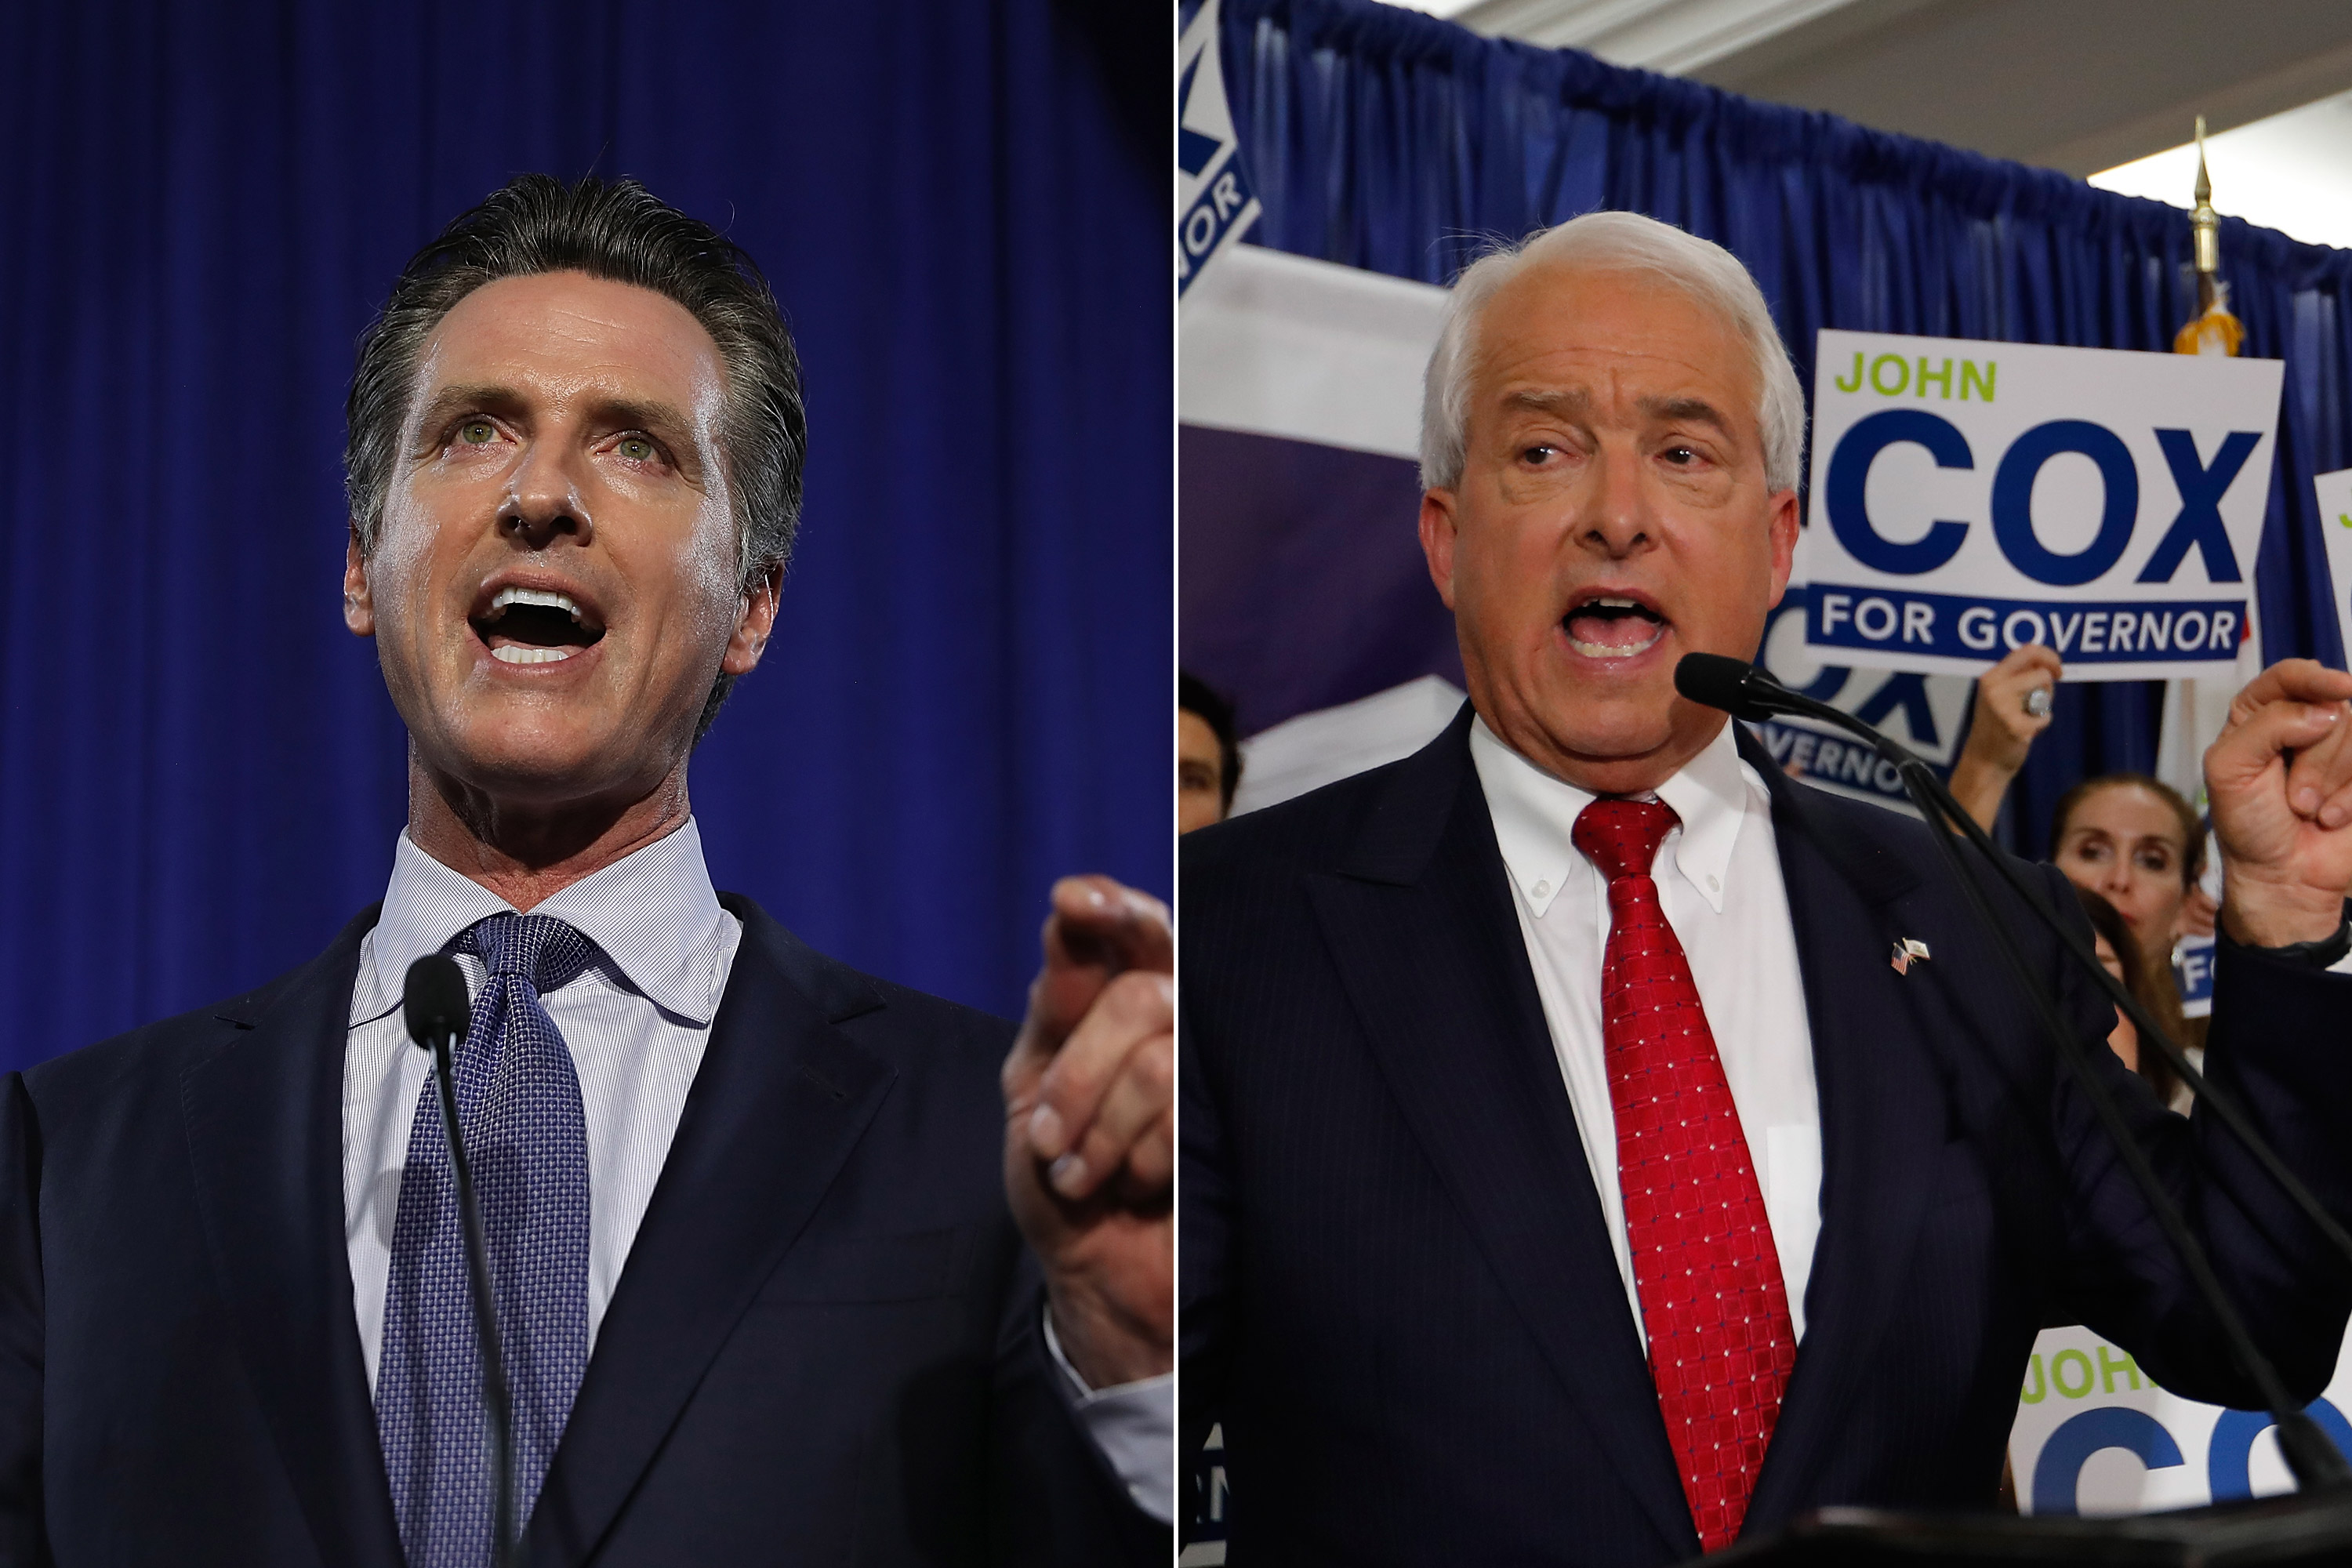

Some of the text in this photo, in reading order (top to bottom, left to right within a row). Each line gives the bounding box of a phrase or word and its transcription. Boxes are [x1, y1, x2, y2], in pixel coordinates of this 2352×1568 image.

[1835, 352, 1997, 403] JOHN
[1824, 408, 2265, 587] COX
[1821, 593, 2237, 653] FOR GOVERNOR
[2020, 1345, 2159, 1404] JOH
